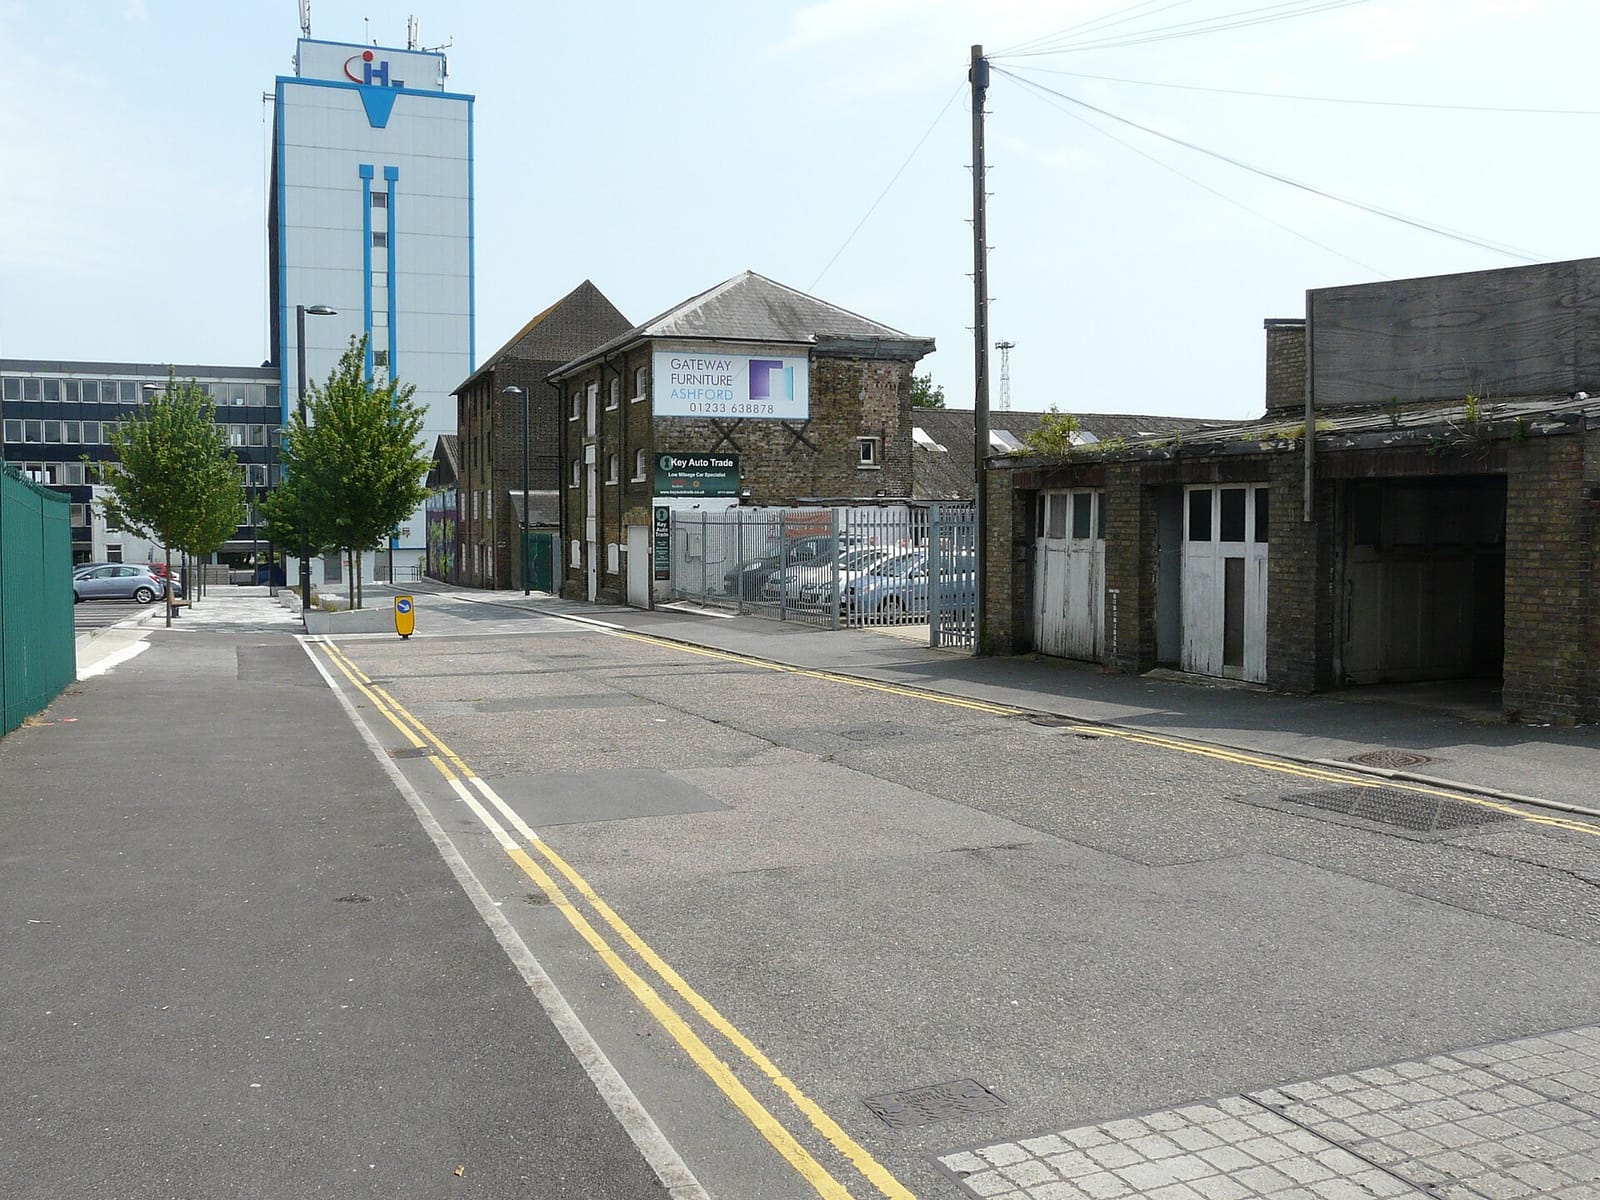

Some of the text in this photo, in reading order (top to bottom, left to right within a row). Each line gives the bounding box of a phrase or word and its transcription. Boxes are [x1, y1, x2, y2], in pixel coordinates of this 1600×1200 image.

[670, 358, 732, 372] GATEWAY
[671, 373, 733, 386] FURNITURE
[670, 388, 734, 401] ASHFORD
[689, 402, 774, 414] 01233 638878
[671, 458, 734, 468] Key Auto Trade
